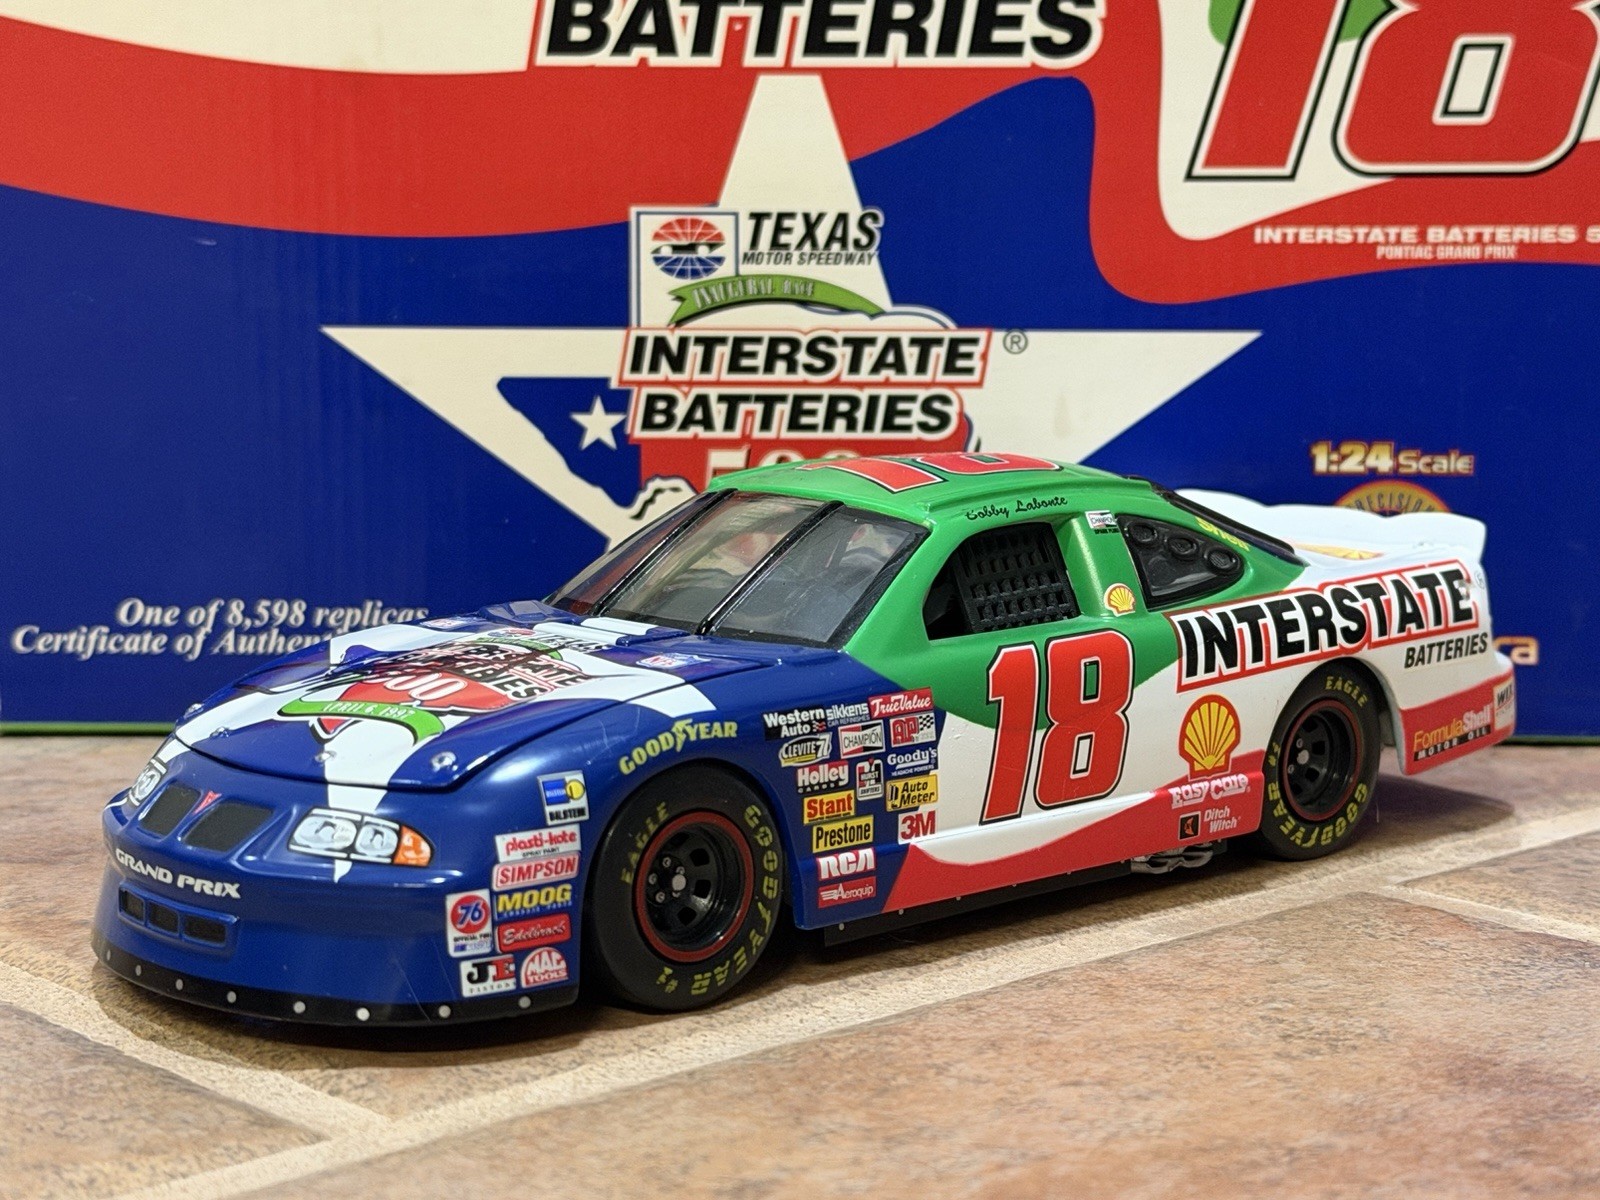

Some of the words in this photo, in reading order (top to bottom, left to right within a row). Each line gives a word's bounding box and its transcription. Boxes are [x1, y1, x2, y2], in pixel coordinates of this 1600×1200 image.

[546, 0, 1096, 57] BATTERIES
[748, 211, 879, 253] TEXAS
[1254, 225, 1418, 244] INTERSTATE
[1427, 225, 1577, 244] BATTERIES
[742, 252, 794, 266] MOTOR
[797, 252, 875, 266] SPEEDWAY
[1377, 245, 1433, 260] PONTIAC
[1437, 245, 1482, 260] GRAND
[1485, 245, 1518, 260] PRIX
[629, 335, 980, 377] INTERSTATE
[641, 394, 954, 433] BATTERIES
[1311, 440, 1395, 475] 1:24
[1397, 449, 1474, 475] Scale
[118, 599, 180, 627] One
[187, 599, 225, 636] of
[227, 599, 307, 631] 8,598
[1180, 569, 1474, 679] INTERSTATE
[13, 624, 168, 661] Certificate
[176, 626, 209, 661] of
[1404, 632, 1488, 669] BATTERIES
[1325, 676, 1368, 708] EAGLE
[763, 708, 825, 728] Western
[826, 703, 869, 720] sikkens
[781, 723, 811, 738] Auto
[979, 627, 1134, 826] 18
[782, 741, 816, 759] CLEVITE
[843, 731, 882, 749] CHAMPION
[1417, 739, 1458, 760] MOTOR
[1467, 727, 1488, 741] OIL
[887, 747, 938, 766] Goody's
[797, 762, 849, 787] Holley
[901, 781, 928, 794] Auto
[806, 793, 853, 818] Stant
[900, 790, 936, 807] Meter
[901, 810, 936, 840] 3M
[1204, 806, 1231, 821] Ditch
[1209, 817, 1238, 833] Witch
[505, 830, 578, 856] plasti-kote
[816, 823, 871, 849] Prestone
[115, 848, 173, 884] GRAND
[177, 874, 241, 899] PRIX
[499, 857, 577, 884] SIMPSON
[819, 848, 875, 879] RCA
[497, 884, 573, 912] MOOG
[835, 883, 874, 900] Aeroquip
[458, 900, 484, 928] 76
[530, 949, 564, 972] MAC
[528, 969, 568, 983] TOOLS
